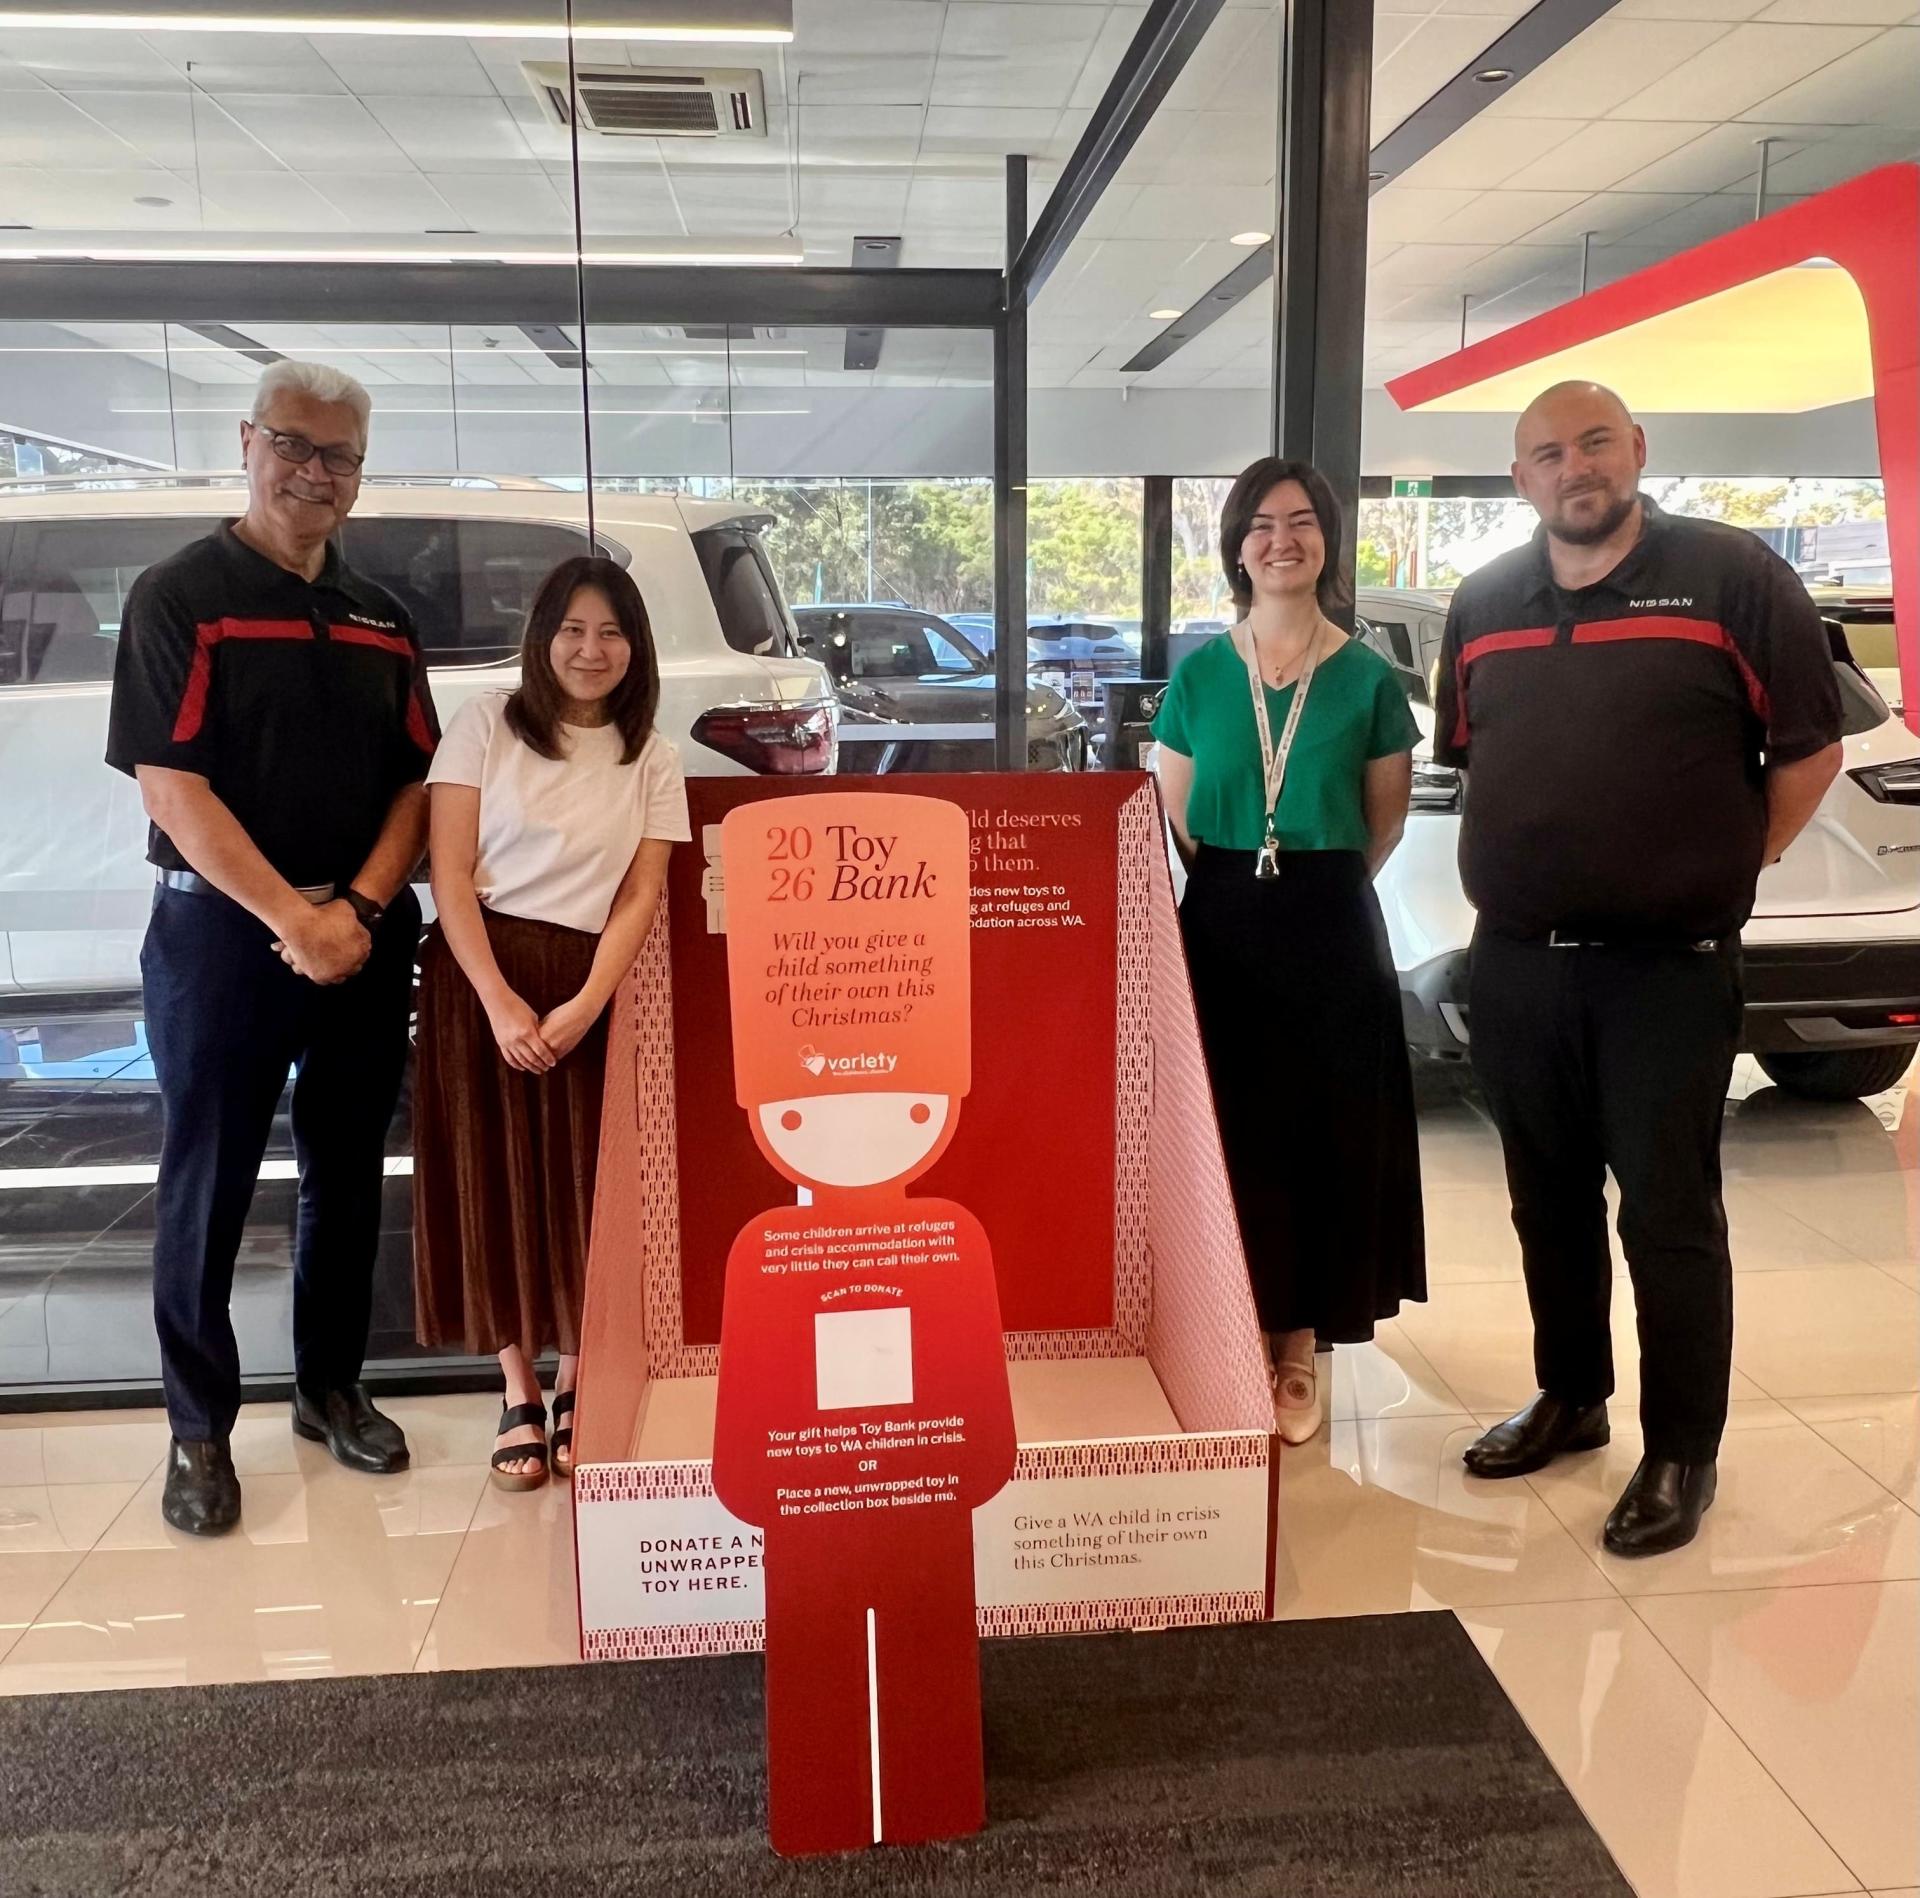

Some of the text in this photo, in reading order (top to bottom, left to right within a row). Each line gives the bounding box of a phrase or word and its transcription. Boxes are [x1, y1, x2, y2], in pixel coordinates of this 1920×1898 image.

[1629, 597, 1693, 608] NISSAN
[996, 809, 1082, 828] deserves
[766, 825, 898, 871] 20 Toy
[987, 831, 1027, 849] that
[985, 853, 1040, 872] them.
[767, 861, 937, 901] 26 Bank
[994, 887, 1020, 897] new
[1023, 886, 1050, 897] toys
[1053, 886, 1065, 895] to
[981, 902, 993, 912] at
[996, 900, 1044, 914] refuges
[1047, 900, 1070, 911] and
[1017, 917, 1058, 928] across
[773, 929, 926, 955] Will you give a
[766, 954, 934, 978] child something
[765, 978, 935, 1006] of their own this
[792, 1003, 913, 1028] Christmas?
[828, 1052, 898, 1072] variety
[764, 1221, 955, 1242] Some children arrive at refuges
[765, 1235, 955, 1258] and crisis accommodation with
[761, 1252, 960, 1274] very little they can call their own.
[820, 1284, 903, 1302] SCAN TO DONATE
[768, 1416, 965, 1442] Your gift helps Toy Bank provide
[766, 1432, 966, 1458] new toys to WA children in crisis.
[858, 1460, 877, 1472] OR
[777, 1473, 959, 1500] Place a new, unwrapped toy in
[780, 1492, 957, 1516] the collection box beside me.
[1014, 1505, 1220, 1531] Give a WA child in crisis
[640, 1534, 763, 1554] DONATE A N
[1014, 1528, 1208, 1550] something of their own
[1014, 1551, 1142, 1570] this Christmas.
[642, 1576, 748, 1594] TOY HERE.
